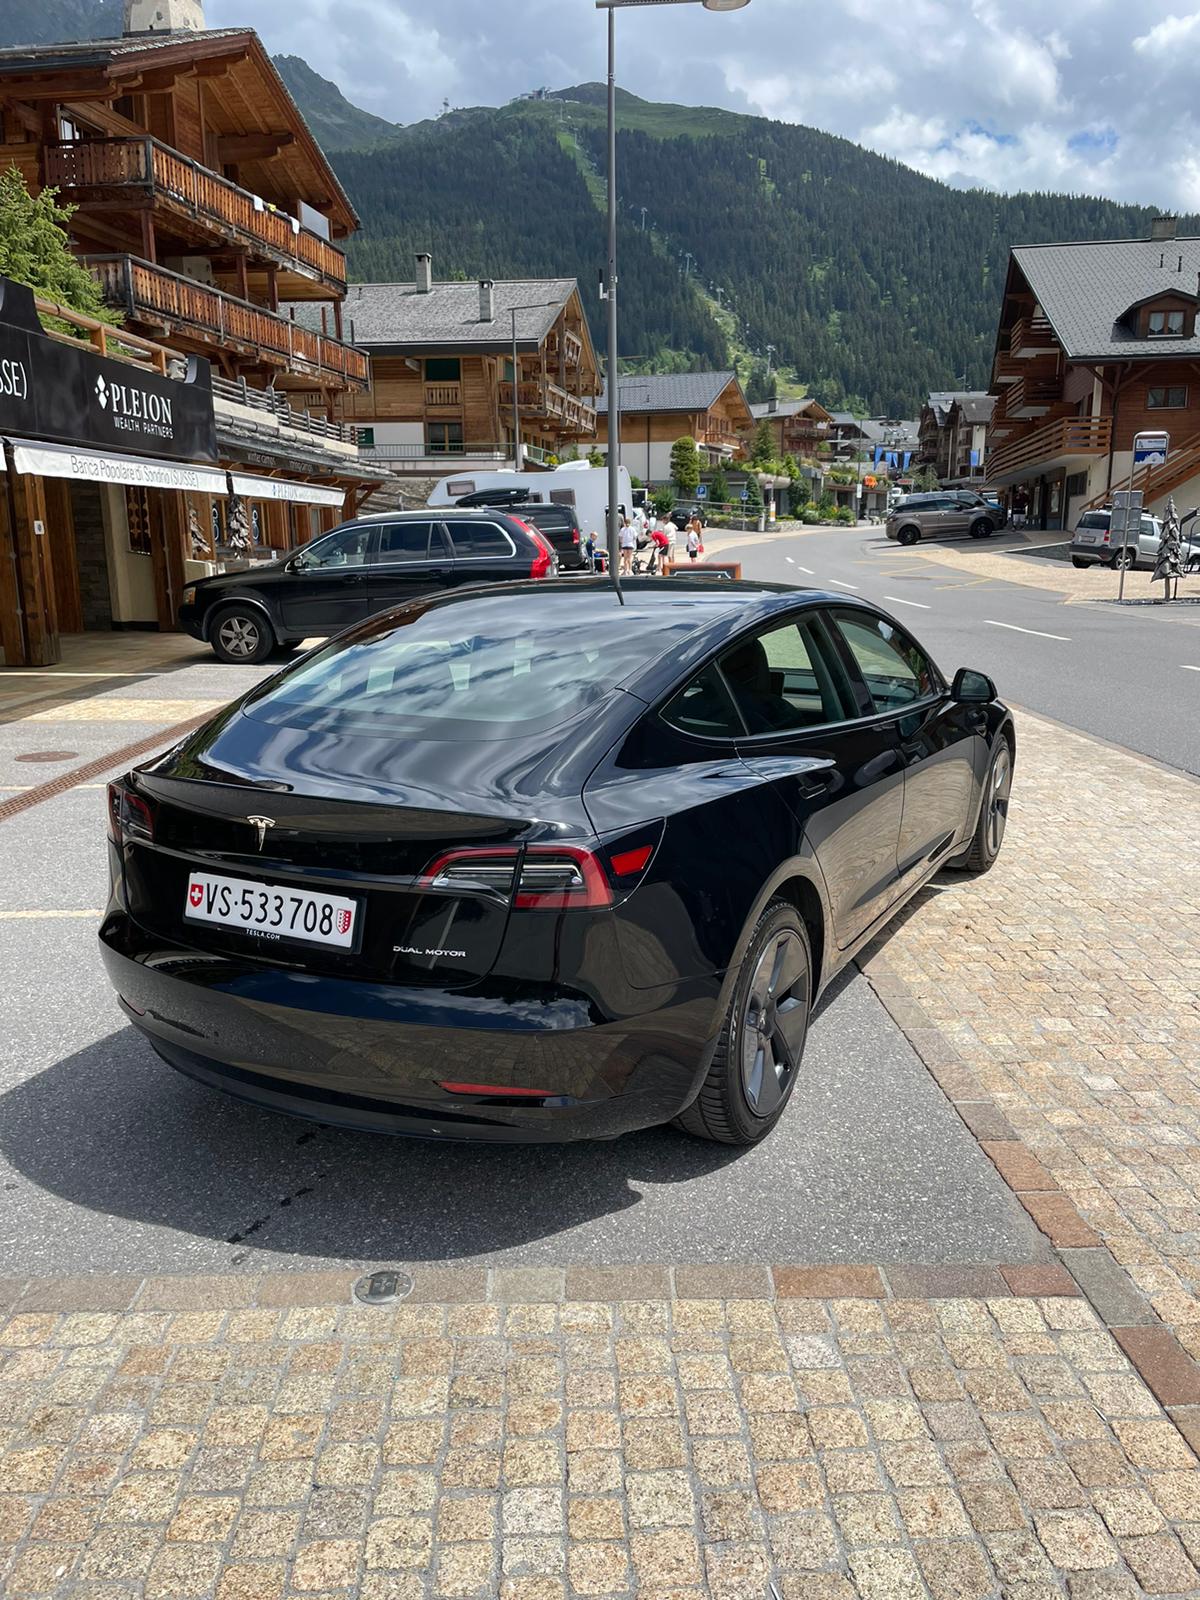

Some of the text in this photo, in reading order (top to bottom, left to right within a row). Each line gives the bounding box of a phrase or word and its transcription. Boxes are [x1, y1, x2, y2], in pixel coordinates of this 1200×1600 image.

[110, 383, 173, 425] PLEION
[113, 416, 174, 439] WEALTH PARTNERS
[71, 455, 99, 476] Banca
[100, 459, 135, 481] Popolare
[136, 465, 143, 481] di
[277, 484, 298, 500] PLEION
[246, 928, 280, 940] TESLA.COM
[392, 945, 467, 958] DUAL MOTOR
